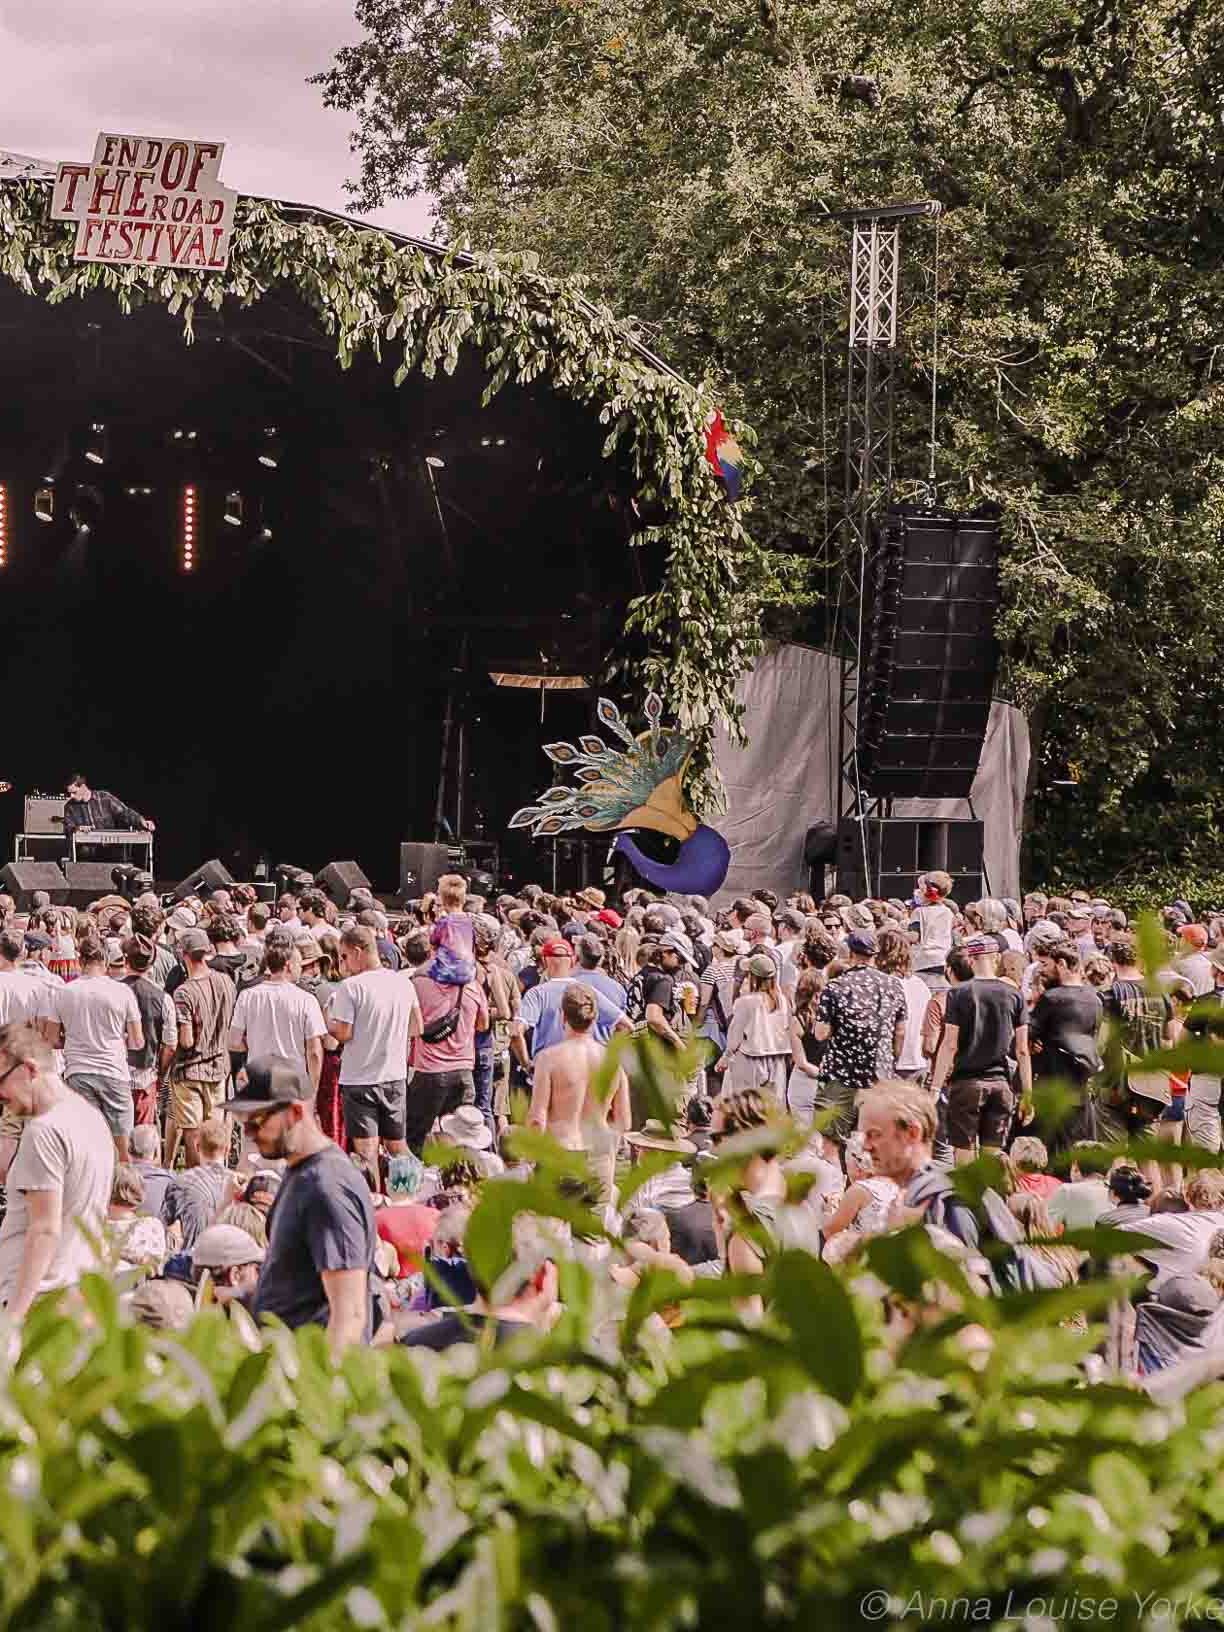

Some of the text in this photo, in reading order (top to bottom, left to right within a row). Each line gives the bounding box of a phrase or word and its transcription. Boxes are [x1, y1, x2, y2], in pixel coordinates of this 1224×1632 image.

[100, 136, 218, 192] END OF
[58, 165, 225, 225] THE ROAD
[76, 218, 225, 267] FESTIVAL
